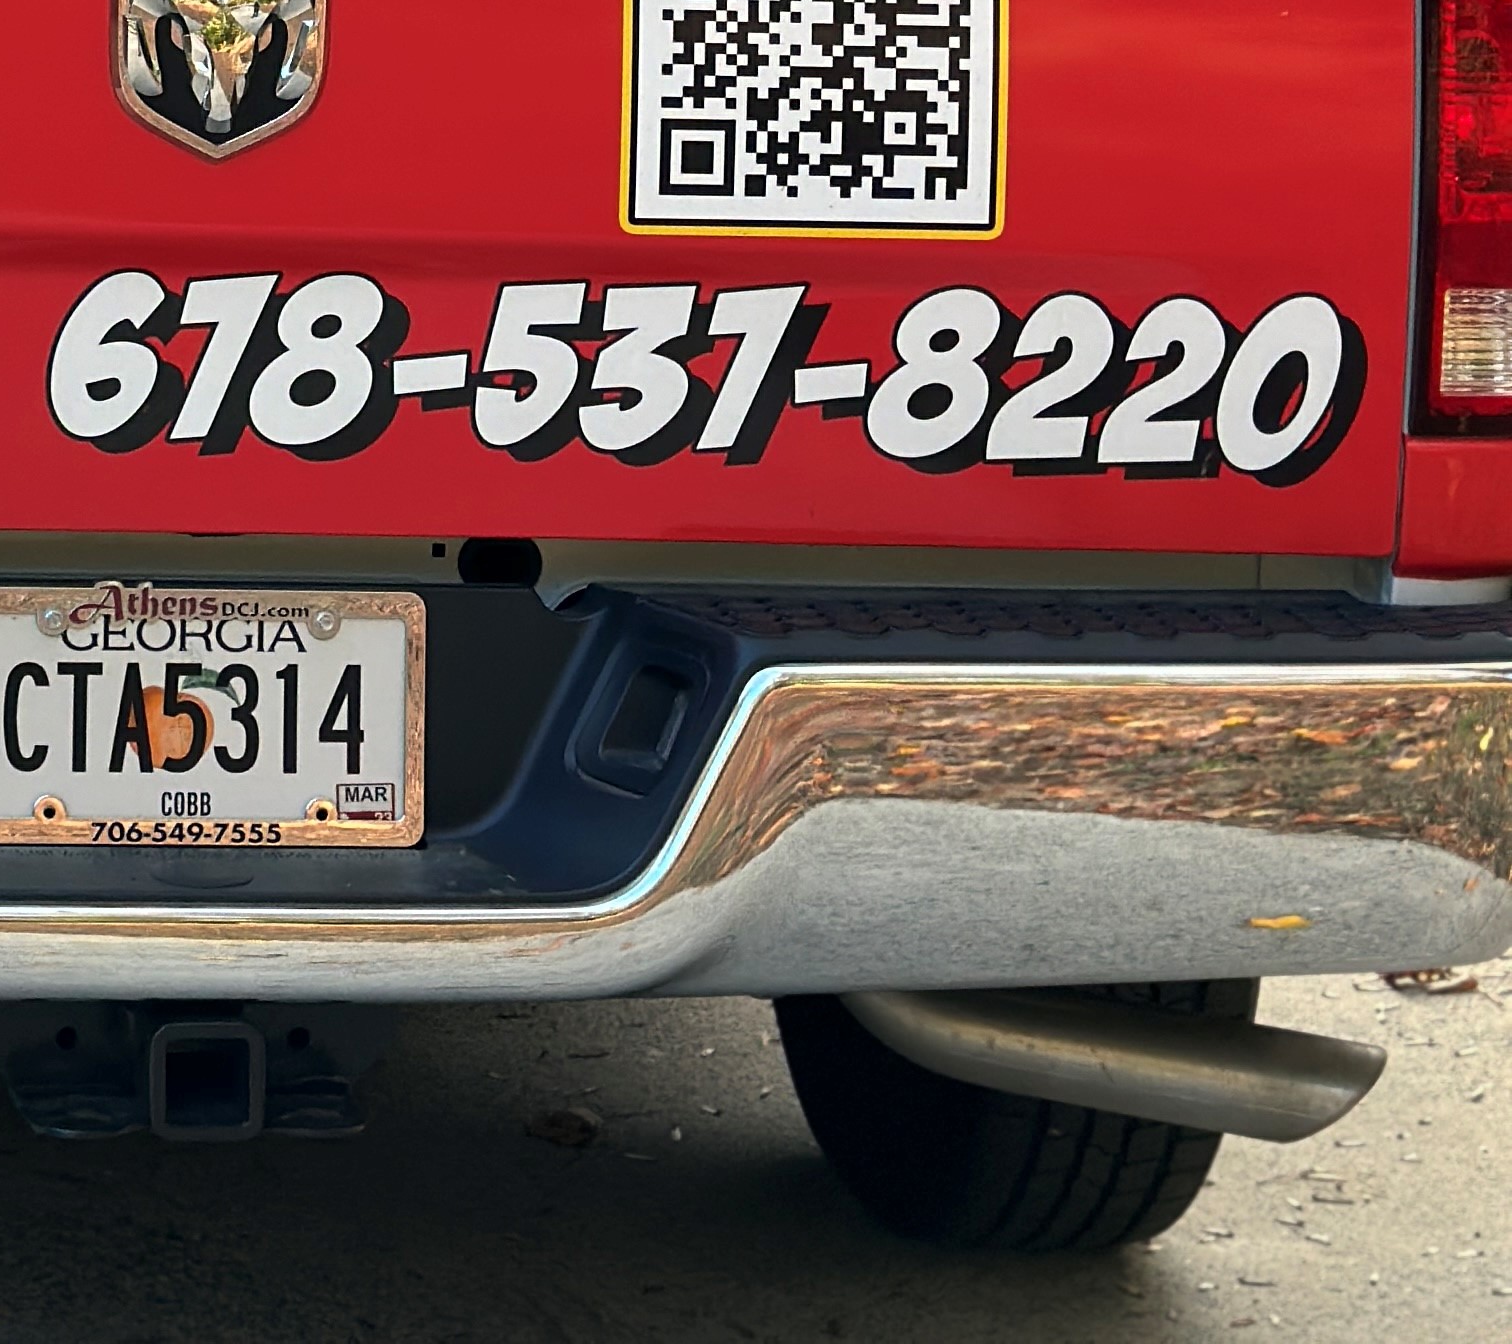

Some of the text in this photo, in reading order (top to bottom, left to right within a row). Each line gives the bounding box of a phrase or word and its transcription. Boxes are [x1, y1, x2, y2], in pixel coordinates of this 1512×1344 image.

[45, 269, 1363, 486] 678-537-8220
[61, 614, 308, 652] GEORGIA
[2, 661, 365, 775] CTA5314
[160, 791, 212, 817] COBB
[344, 786, 388, 803] MAR
[90, 821, 283, 844] 706-549-7555
